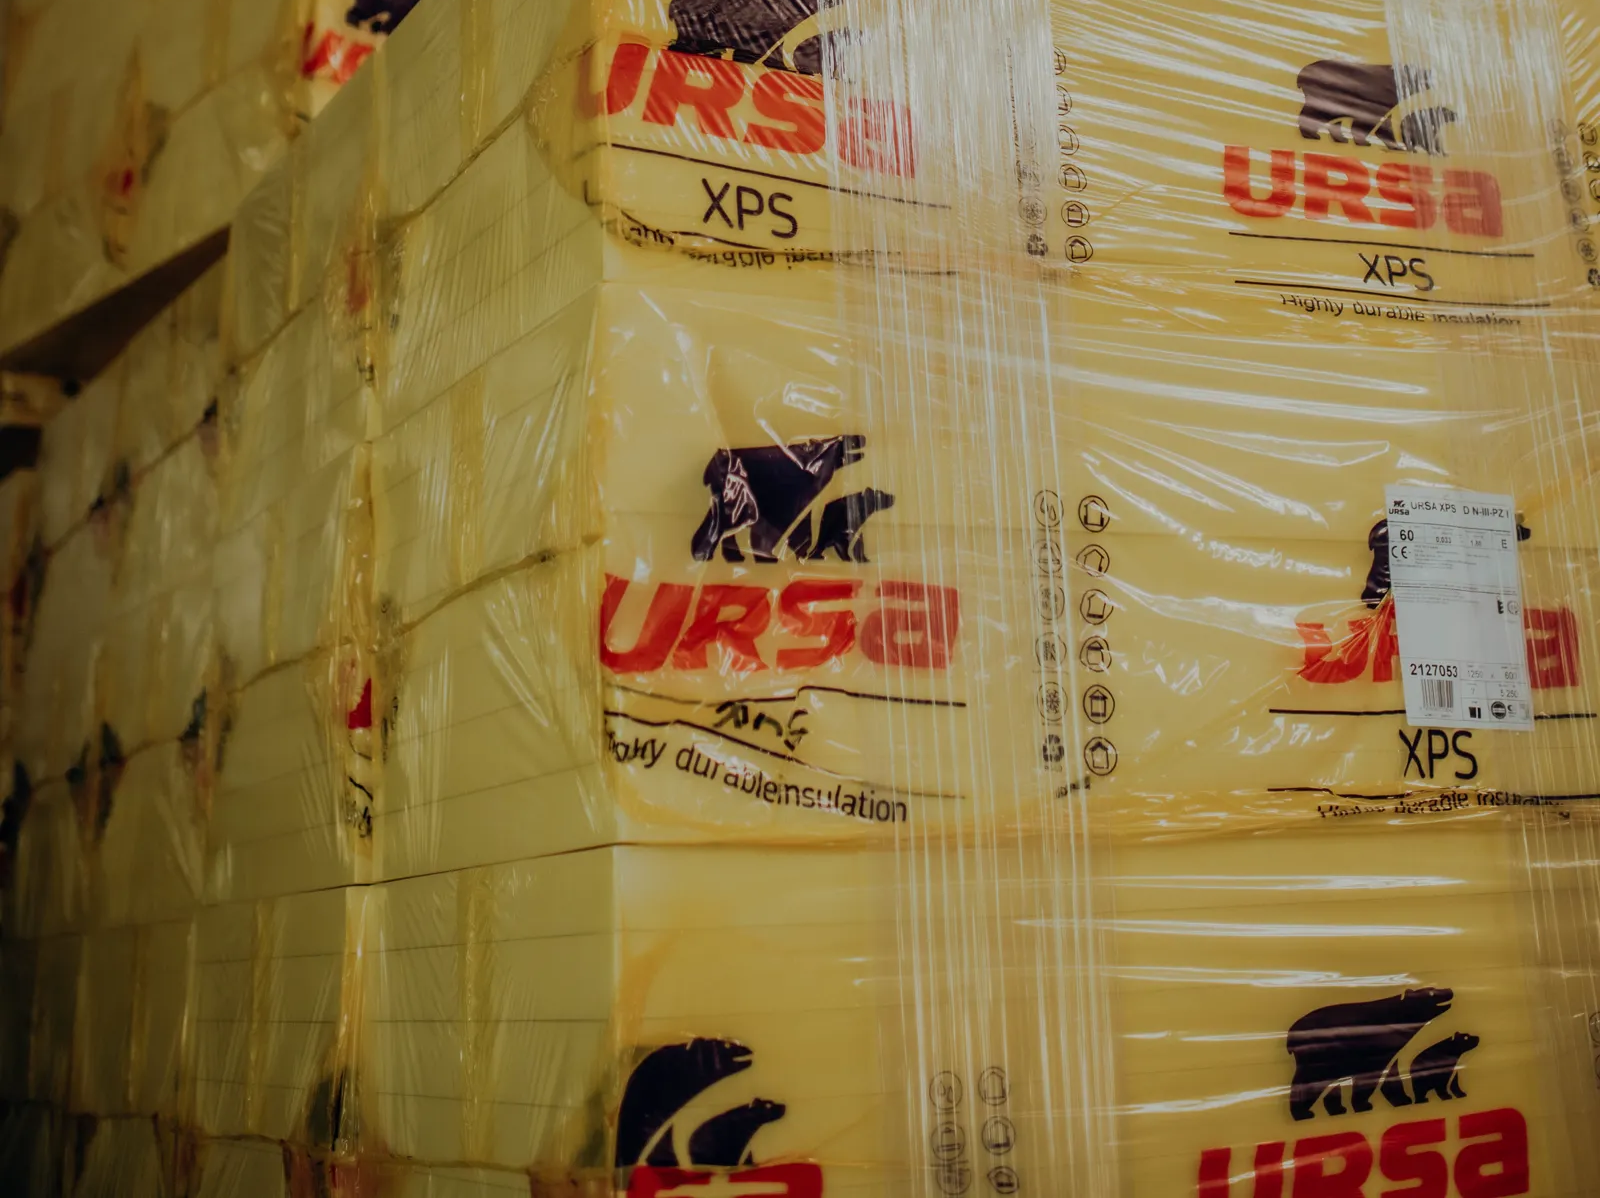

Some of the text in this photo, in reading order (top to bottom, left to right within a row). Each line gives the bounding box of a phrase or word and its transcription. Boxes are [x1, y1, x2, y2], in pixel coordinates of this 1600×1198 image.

[701, 178, 798, 239] XPS
[1223, 145, 1504, 238] URSa
[1357, 253, 1435, 292] XPS
[1352, 301, 1425, 323] durable
[1440, 504, 1457, 514] XPS
[1399, 529, 1415, 542] 60
[600, 572, 960, 675] URSa
[1410, 663, 1458, 678] 2127053
[1399, 728, 1479, 780] XPS
